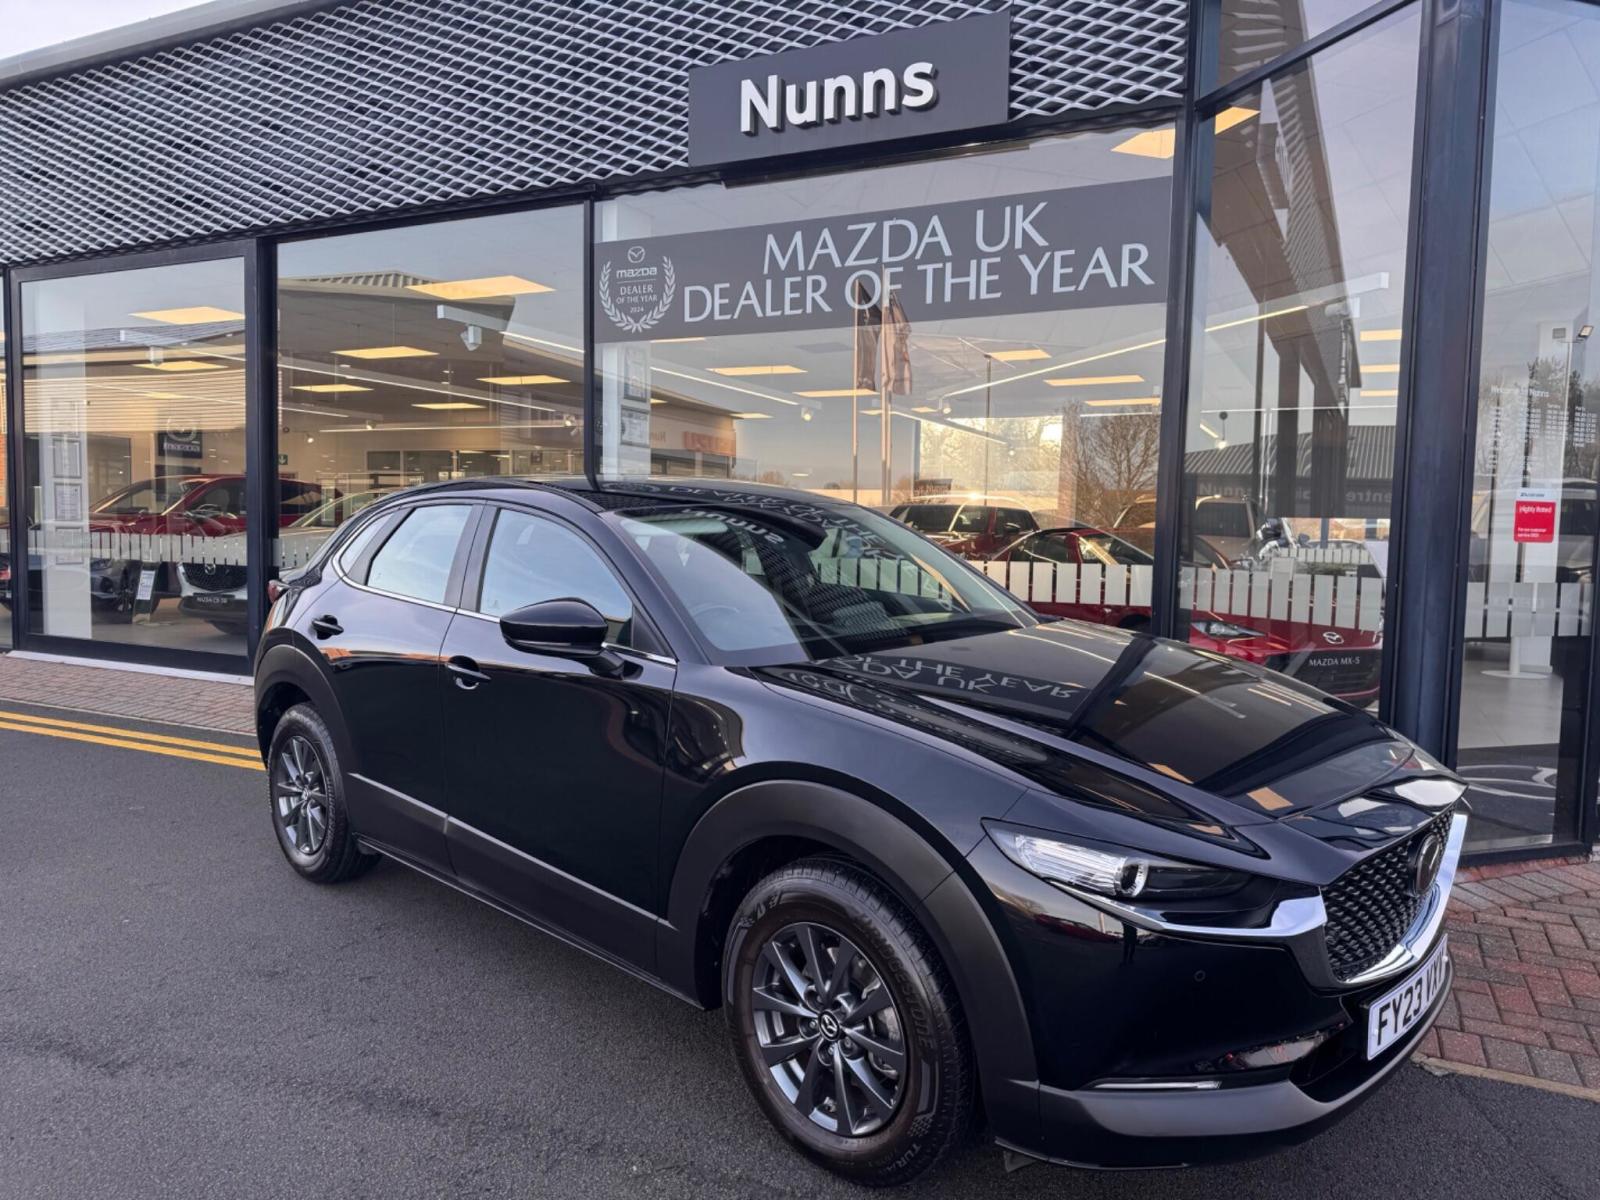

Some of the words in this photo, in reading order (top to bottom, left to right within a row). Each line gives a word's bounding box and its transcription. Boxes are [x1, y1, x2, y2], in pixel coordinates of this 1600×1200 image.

[741, 62, 936, 135] Nunns
[763, 214, 953, 275] MAZDA
[975, 201, 1049, 253] UK
[620, 284, 654, 296] DEALER
[640, 294, 658, 303] YEAR
[684, 275, 833, 323] DEALER
[844, 266, 904, 310] OF
[917, 256, 1002, 305] THE
[1018, 243, 1155, 296] YEAR
[1308, 658, 1338, 667] MAZDA
[1377, 976, 1422, 1046] FY23
